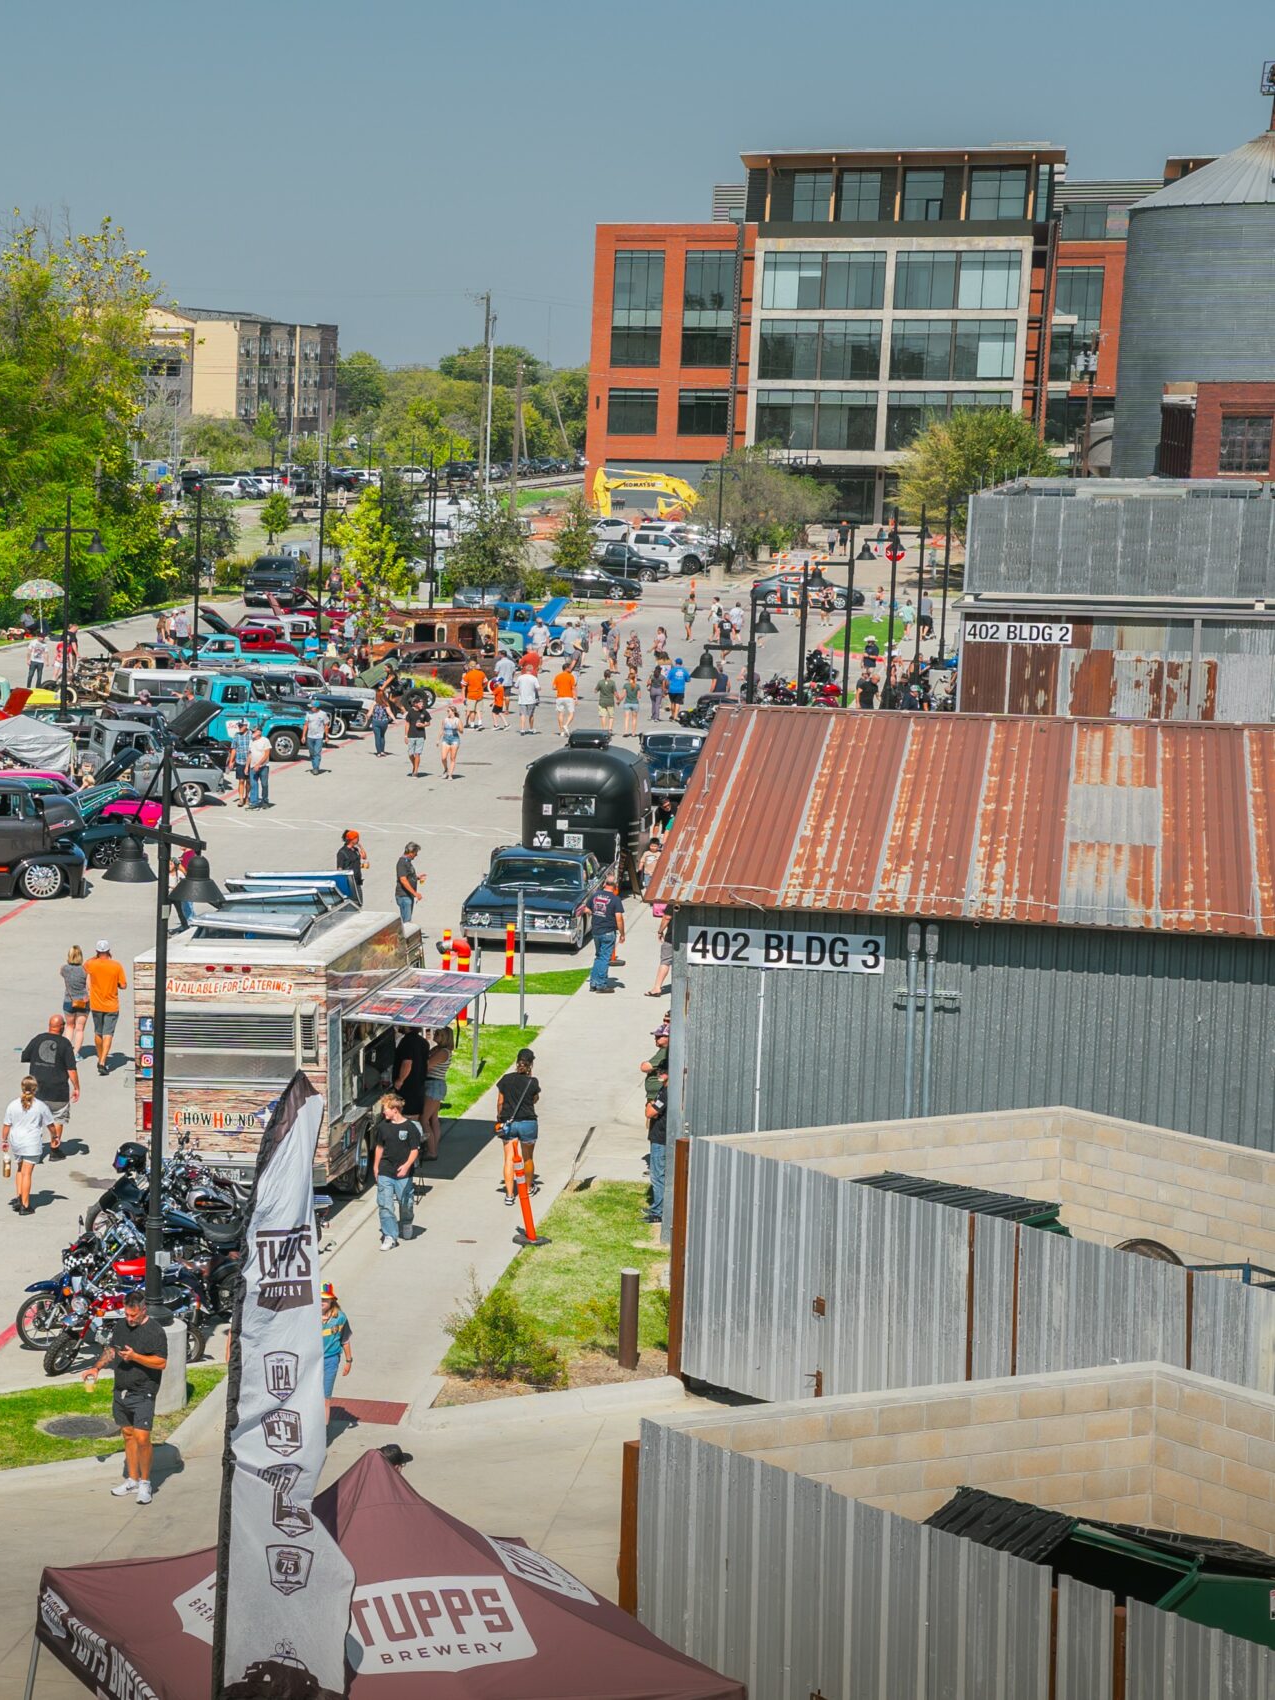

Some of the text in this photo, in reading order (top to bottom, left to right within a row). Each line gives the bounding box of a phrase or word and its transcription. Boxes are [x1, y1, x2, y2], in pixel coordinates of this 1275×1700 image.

[967, 623, 1069, 642] 402 BLDG 2
[691, 930, 881, 969] 402 BLDG 3
[270, 1364, 292, 1390] IPA
[281, 1560, 295, 1574] 75
[351, 1588, 515, 1648] TUPPS
[380, 1642, 504, 1665] BREWERY
